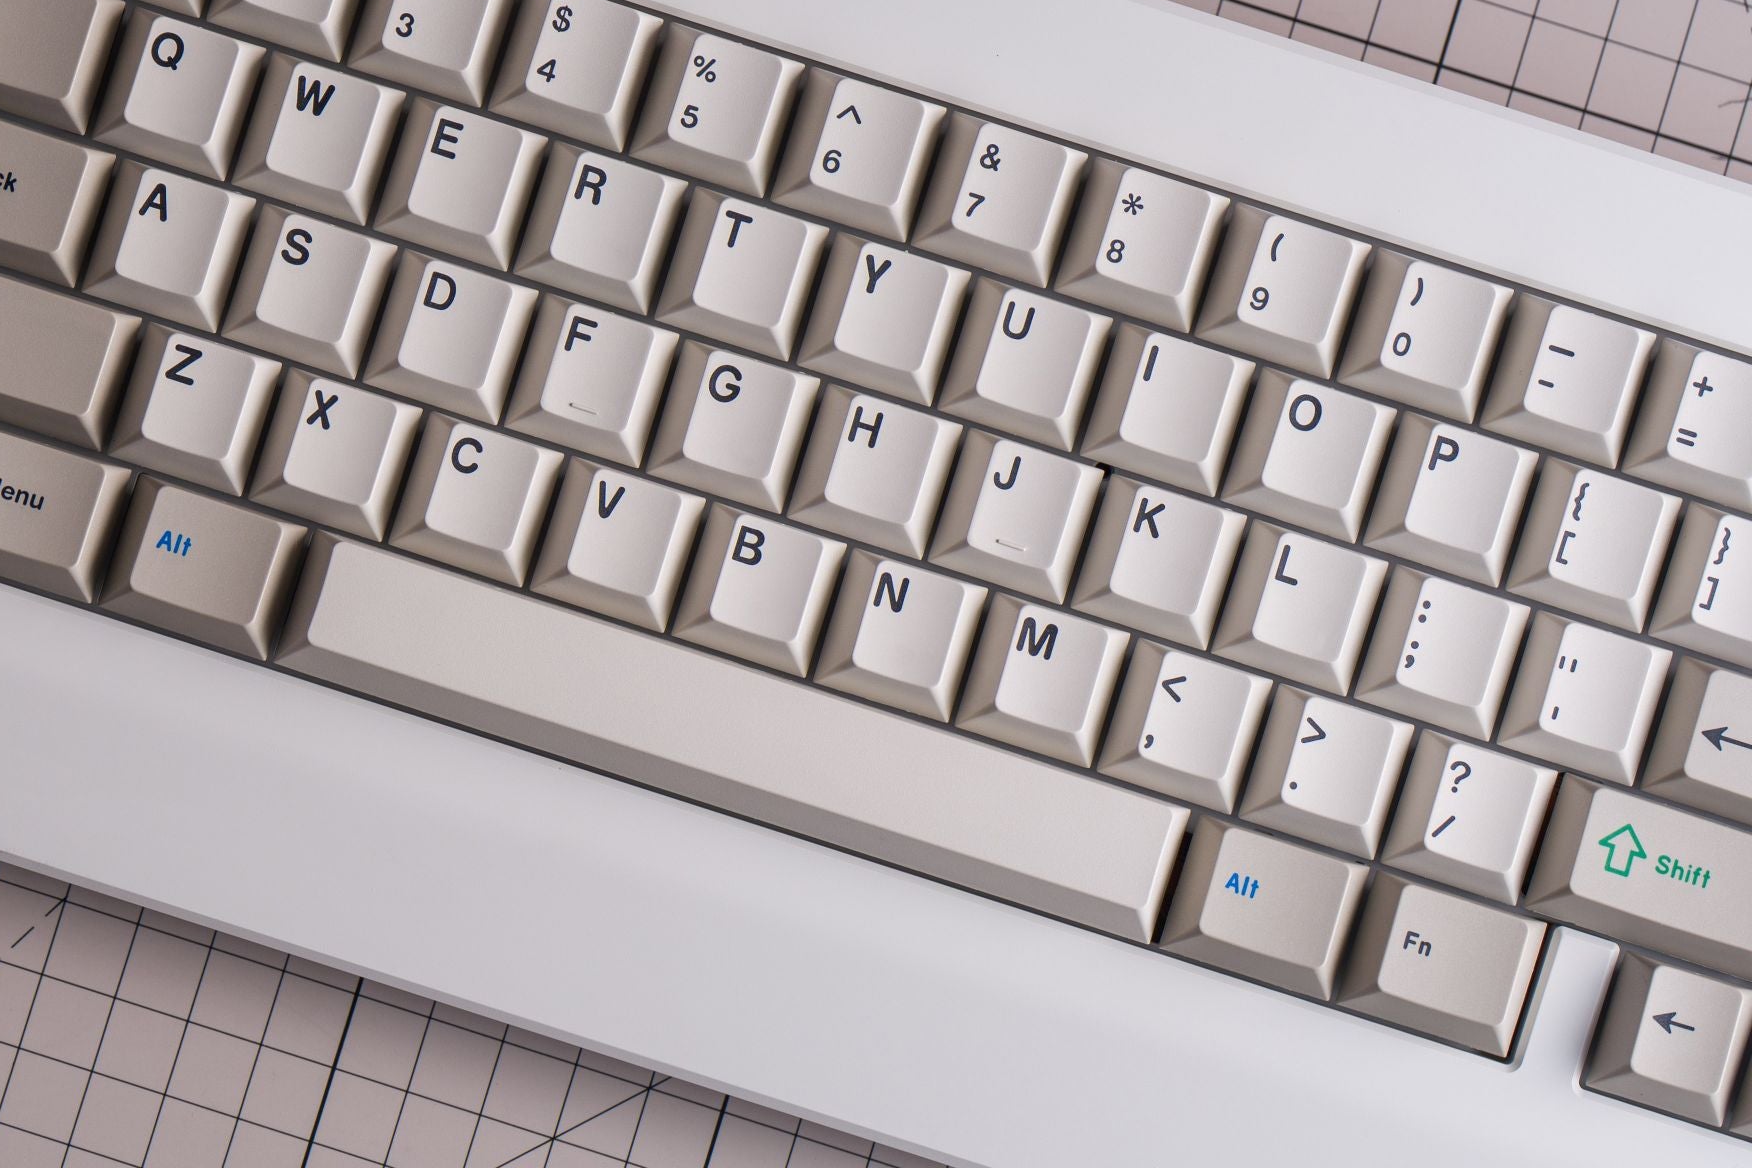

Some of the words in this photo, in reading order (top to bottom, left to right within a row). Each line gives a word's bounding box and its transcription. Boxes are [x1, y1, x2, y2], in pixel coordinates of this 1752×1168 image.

[395, 12, 415, 38] 3
[552, 5, 573, 33] $
[151, 32, 185, 71] Q
[693, 55, 716, 83] %
[536, 59, 556, 83] 4
[296, 75, 336, 117] W
[680, 104, 699, 129] 5
[430, 118, 464, 160] E
[822, 149, 842, 174] 6
[979, 143, 1001, 172] &
[138, 183, 168, 222] A
[574, 164, 607, 206] R
[966, 192, 986, 217] 7
[725, 210, 753, 248] T
[281, 228, 313, 266] S
[1106, 239, 1125, 264] 8
[1270, 233, 1285, 262] (
[423, 271, 457, 311] D
[865, 254, 892, 294] Y
[1410, 277, 1424, 306] )
[1249, 286, 1270, 311] 9
[564, 315, 598, 352] F
[1002, 301, 1036, 340] U
[1392, 332, 1412, 357] 0
[165, 344, 203, 386] Z
[708, 364, 742, 403] G
[1692, 376, 1714, 397] +
[306, 389, 339, 430] X
[1288, 394, 1323, 432] O
[847, 406, 884, 449] H
[1676, 428, 1698, 447] =
[451, 437, 483, 474] C
[1428, 435, 1460, 471] P
[993, 456, 1022, 490] J
[598, 480, 626, 519] V
[1572, 482, 1590, 522] {
[1133, 497, 1166, 539] K
[156, 530, 192, 557] Alt
[731, 525, 765, 566] B
[1555, 530, 1576, 565] [
[1713, 527, 1731, 565] }
[1275, 544, 1298, 586] L
[873, 572, 910, 613] N
[1699, 576, 1720, 611] ]
[1418, 600, 1431, 623] :
[1016, 617, 1059, 660] M
[1404, 641, 1420, 669] ;
[1161, 676, 1187, 703] <
[1301, 717, 1326, 744] >
[1450, 761, 1472, 793] ?
[1431, 815, 1456, 838] /
[1225, 872, 1259, 899] Alt
[1655, 854, 1711, 889] Shift
[1403, 930, 1432, 957] Fn
